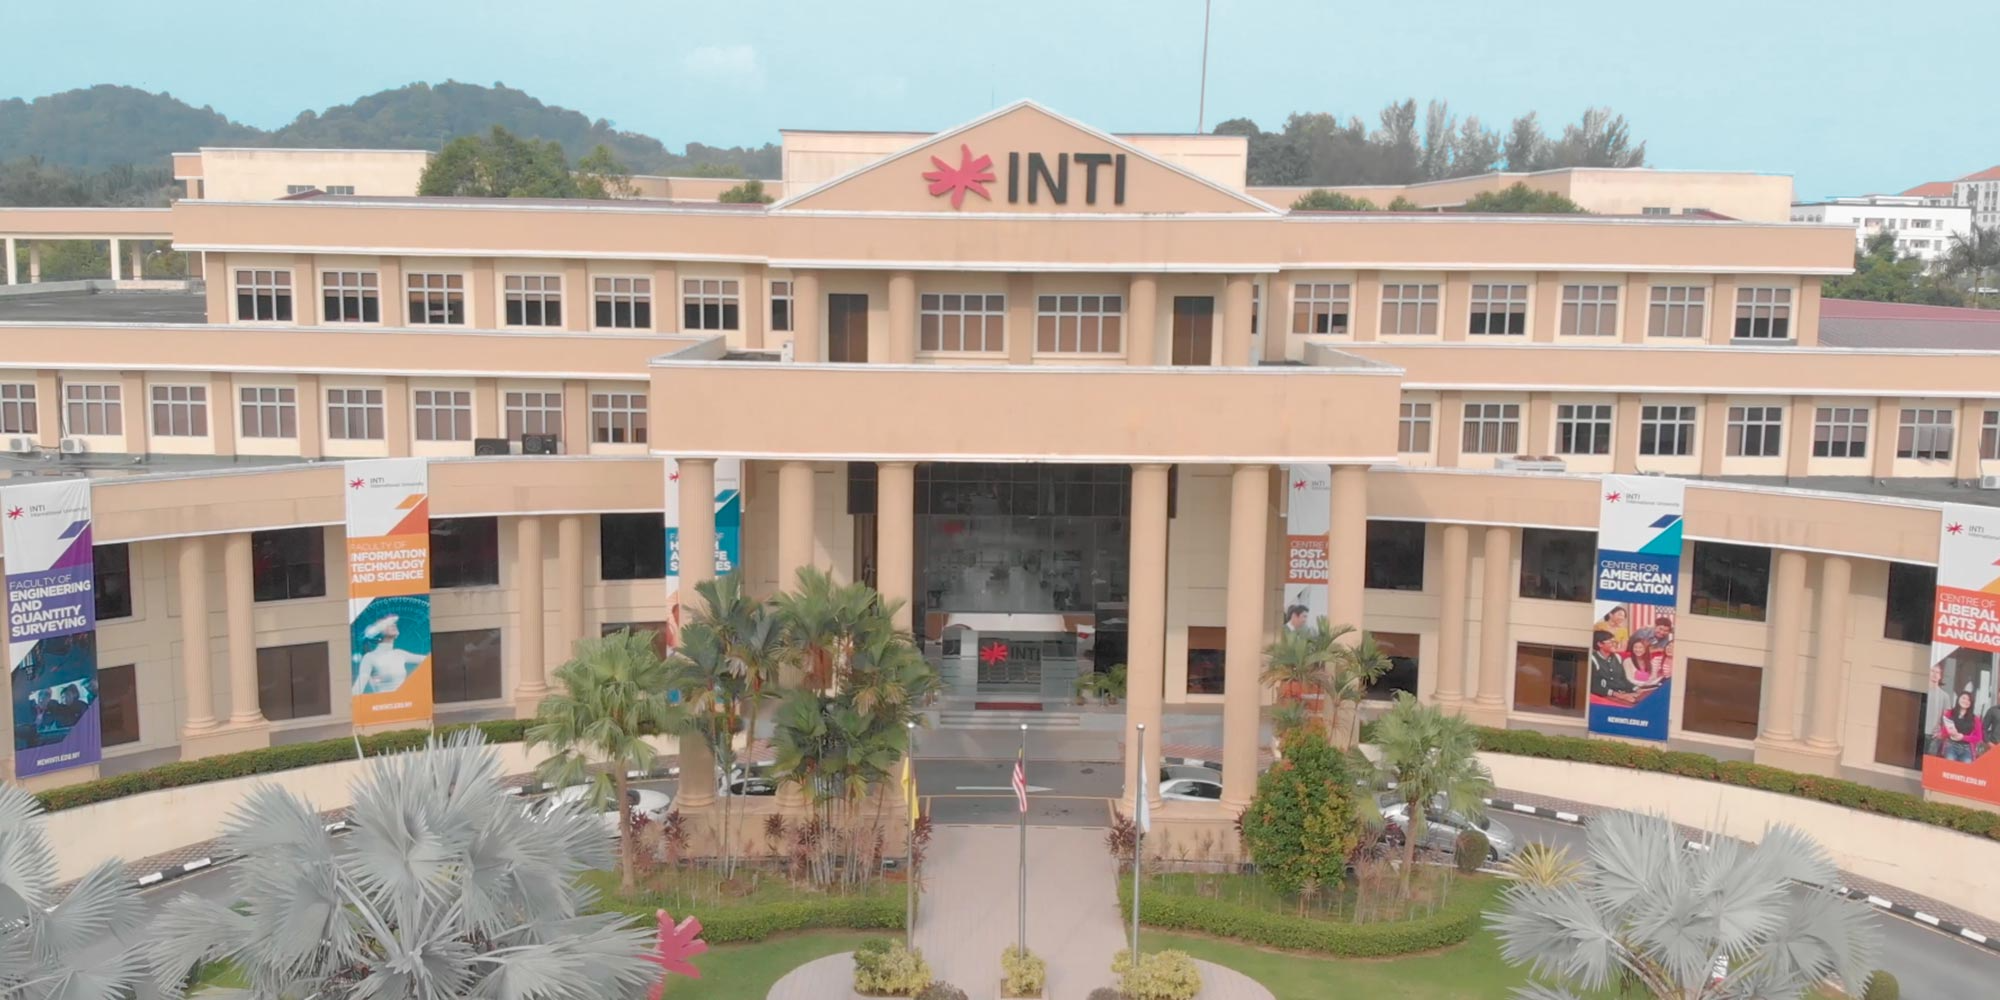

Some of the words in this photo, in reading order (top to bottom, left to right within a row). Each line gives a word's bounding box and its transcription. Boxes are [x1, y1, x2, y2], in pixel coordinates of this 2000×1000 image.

[1008, 151, 1126, 205] INTI
[29, 504, 46, 513] INTI
[1968, 524, 1985, 534] INTI
[351, 548, 427, 562] INFORMATION
[1290, 548, 1326, 559] POST-
[351, 559, 425, 573] TECHNOLOGY
[1289, 569, 1328, 579] STUDI
[1600, 559, 1638, 571] CENTER
[1639, 563, 1660, 573] FOR
[9, 577, 56, 591] FACULTY
[57, 574, 72, 585] OF
[351, 572, 376, 584] AND
[377, 569, 424, 581] SCIENCE
[1600, 568, 1672, 585] AMERICAN
[10, 580, 91, 602] ENGINEERING
[1599, 579, 1675, 596] EDUCATION
[11, 600, 43, 615] AND
[1940, 592, 1979, 607] CENTRE
[1981, 599, 1996, 608] OF
[11, 604, 82, 626] QUANTITY
[1939, 601, 1999, 621] LIBERAL
[12, 616, 87, 637] SURVEYING
[1938, 614, 1977, 631] ARTS
[1978, 620, 2000, 634] AN
[1936, 626, 2000, 646] LANGUAG
[1011, 646, 1040, 661] INTI
